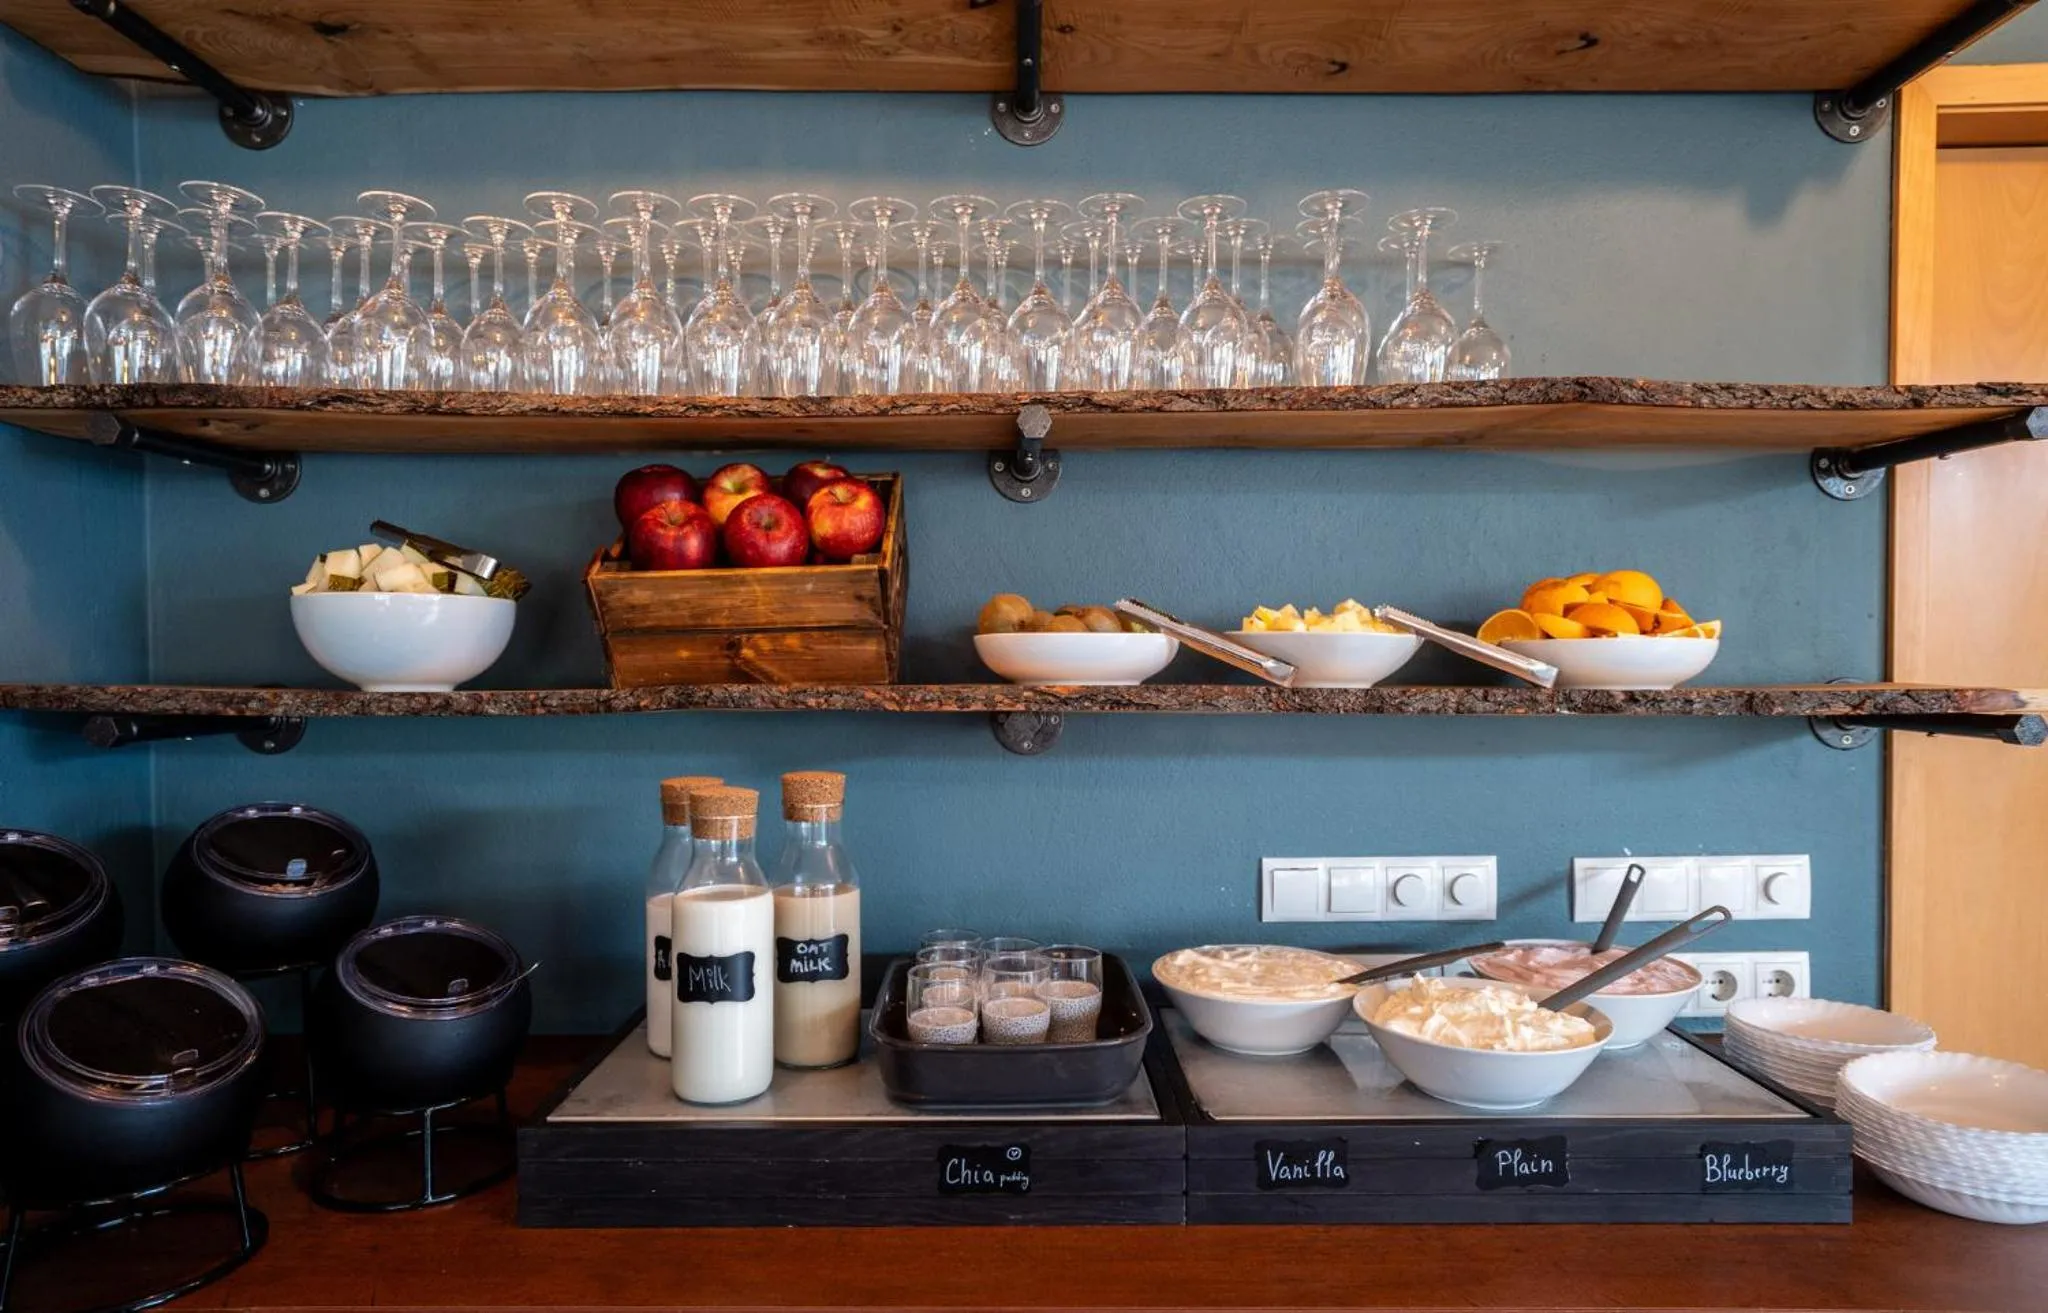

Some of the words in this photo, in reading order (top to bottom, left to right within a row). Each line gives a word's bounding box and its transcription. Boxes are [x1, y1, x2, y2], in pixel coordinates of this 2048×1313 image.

[796, 941, 833, 954] OAT
[688, 964, 732, 993] Milk
[946, 1158, 995, 1184] Chia
[1266, 1149, 1345, 1181] Vanilla
[1494, 1148, 1554, 1177] Plain
[1705, 1153, 1789, 1183] Blueberry
